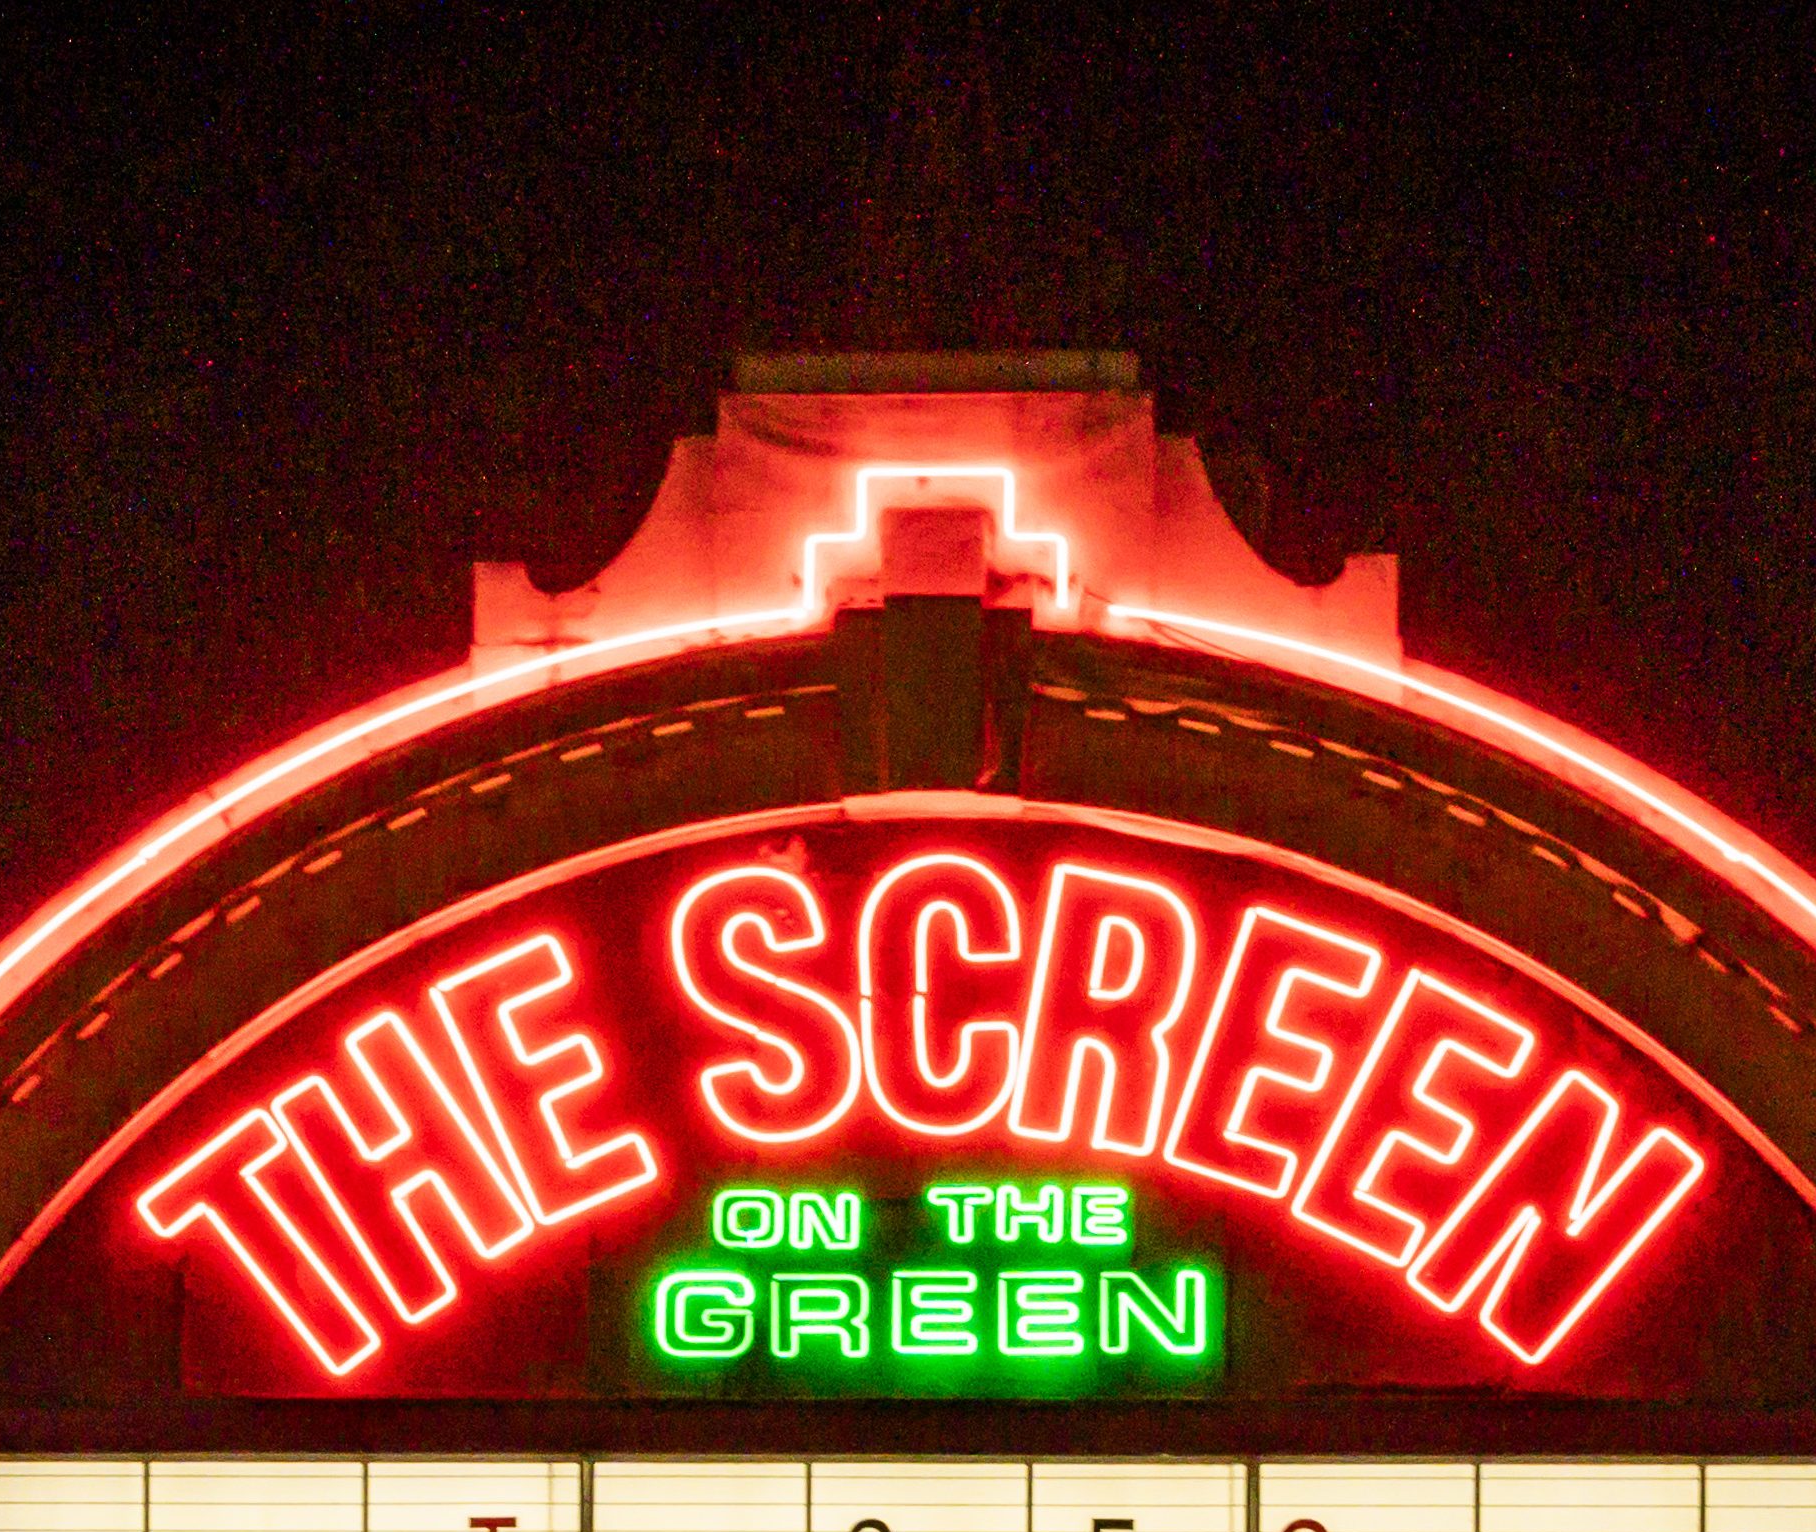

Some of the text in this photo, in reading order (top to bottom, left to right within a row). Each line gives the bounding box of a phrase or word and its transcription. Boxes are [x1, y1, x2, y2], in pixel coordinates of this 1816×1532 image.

[136, 853, 1705, 1378] THE SCREEN
[714, 1184, 1130, 1250] ON THE
[654, 1270, 1207, 1359] GREEN
